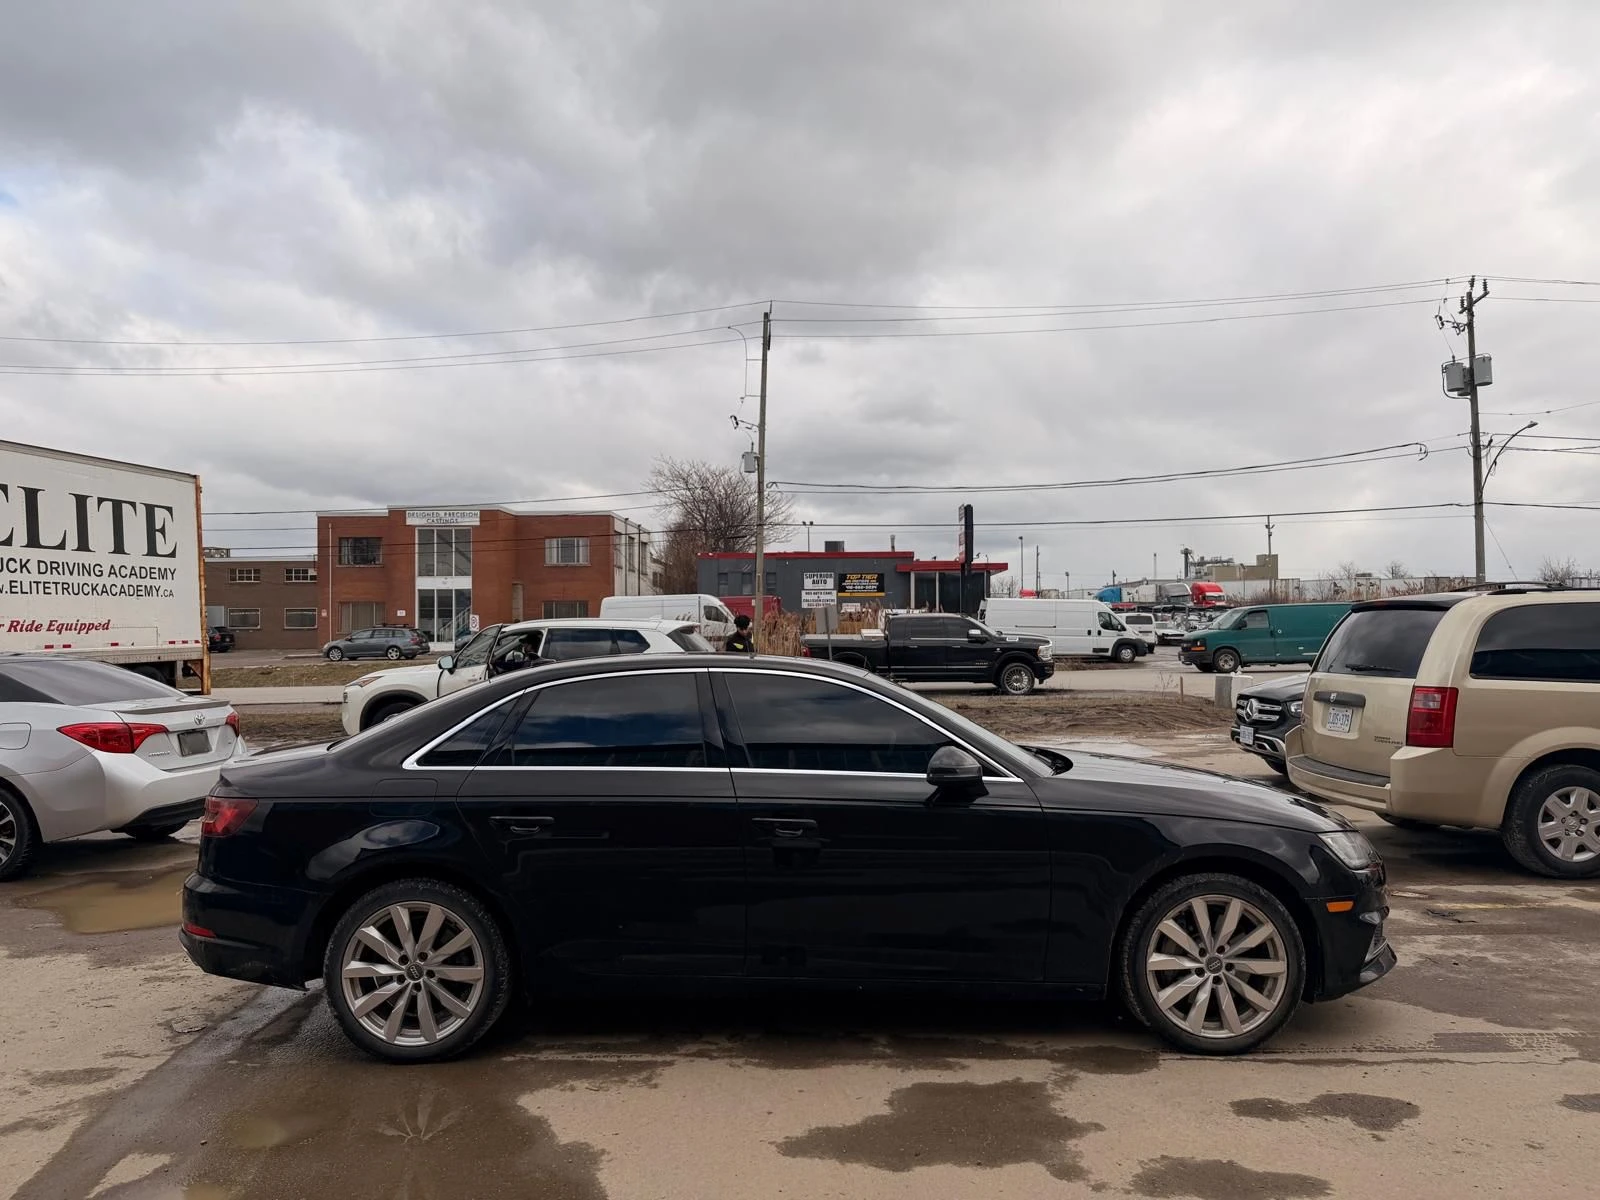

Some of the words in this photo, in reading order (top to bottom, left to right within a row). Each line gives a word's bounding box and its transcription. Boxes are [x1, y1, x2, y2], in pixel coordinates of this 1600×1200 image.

[37, 560, 103, 577] DRIVING
[108, 564, 177, 581] ACADEMY
[7, 619, 43, 633] Ride
[46, 619, 112, 636] Equipped
